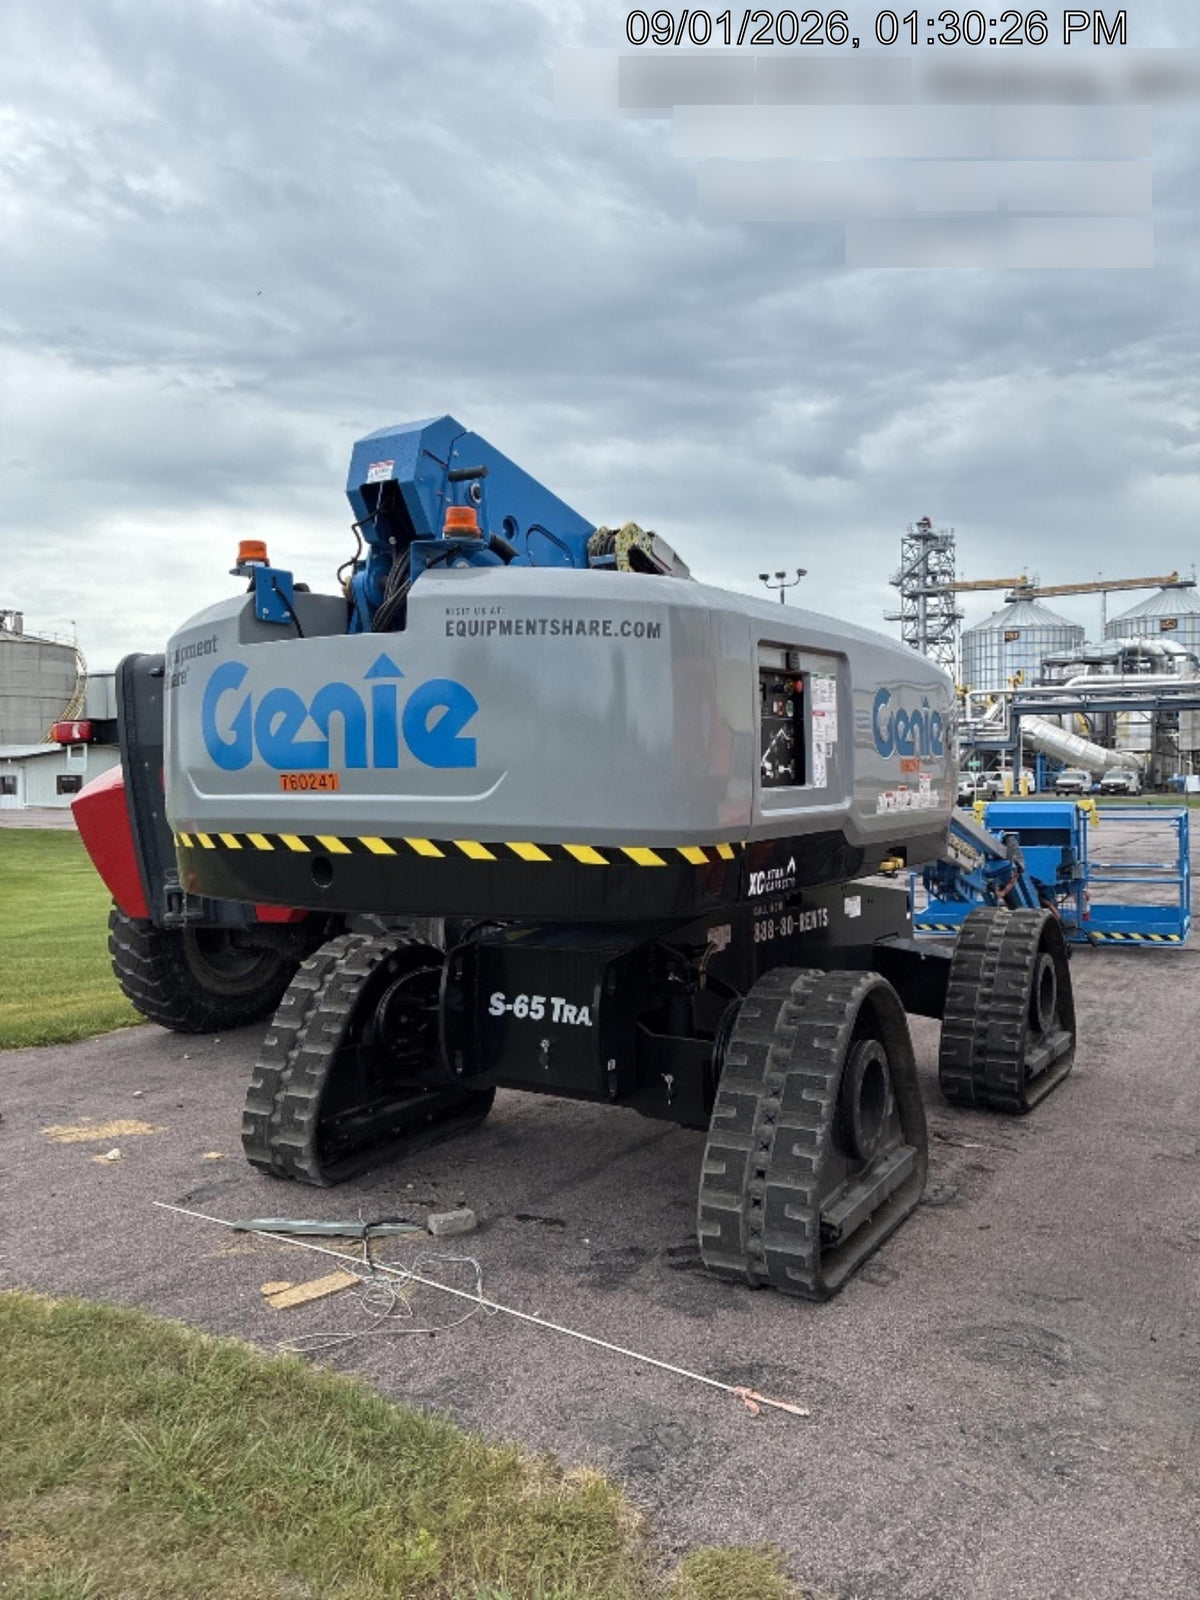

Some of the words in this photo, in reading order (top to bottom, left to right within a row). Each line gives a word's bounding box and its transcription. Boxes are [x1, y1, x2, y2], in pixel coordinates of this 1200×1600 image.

[445, 618, 661, 639] EQUIPMENTSHARE.COM
[202, 653, 479, 770] Genie
[873, 688, 943, 758] Genie
[280, 773, 335, 790] 760241
[748, 870, 765, 897] XC
[488, 991, 547, 1021] S-65
